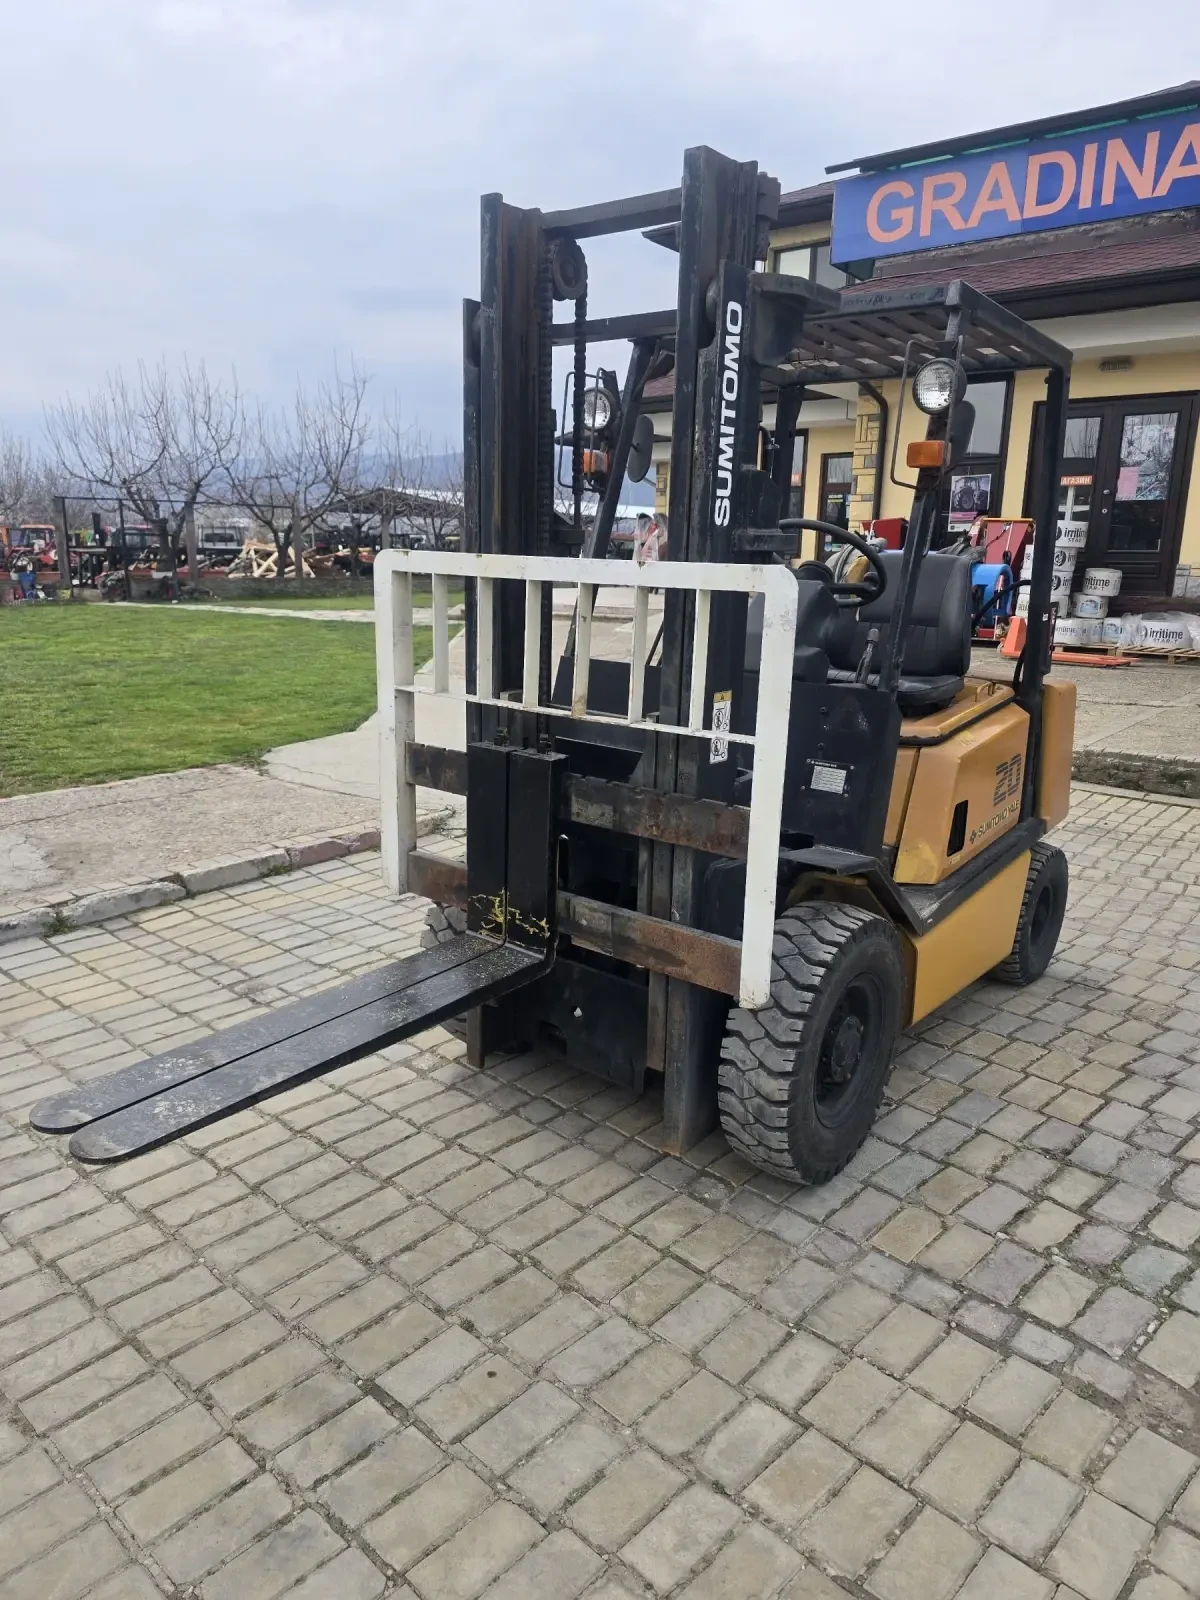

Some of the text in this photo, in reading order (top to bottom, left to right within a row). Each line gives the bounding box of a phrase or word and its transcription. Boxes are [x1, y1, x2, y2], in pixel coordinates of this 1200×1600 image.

[866, 123, 1200, 243] GRADINA
[715, 301, 742, 526] SUMITOMO
[1149, 628, 1183, 639] irritime
[978, 809, 1008, 837] SUMITOMO
